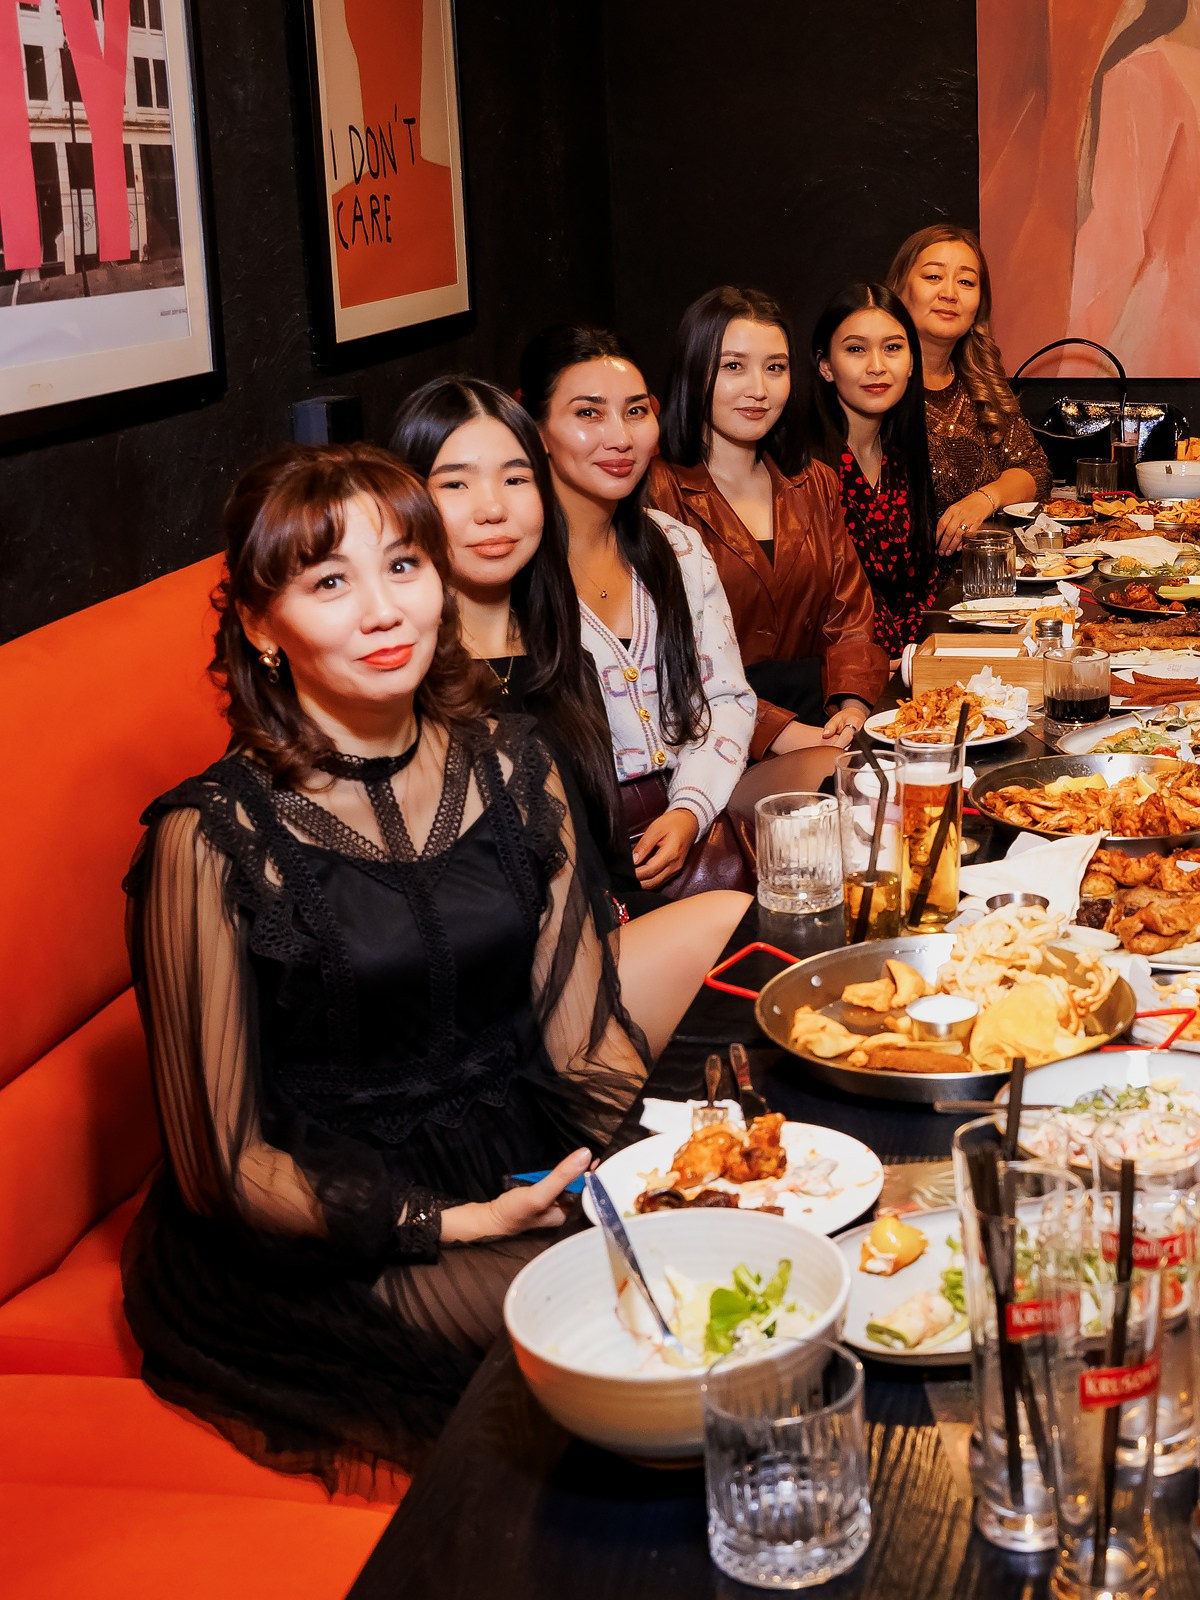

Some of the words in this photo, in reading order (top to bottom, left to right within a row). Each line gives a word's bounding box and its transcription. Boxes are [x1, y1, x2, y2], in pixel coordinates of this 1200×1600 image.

[330, 129, 338, 180] I
[349, 103, 416, 185] DON'T
[336, 194, 392, 250] CARE
